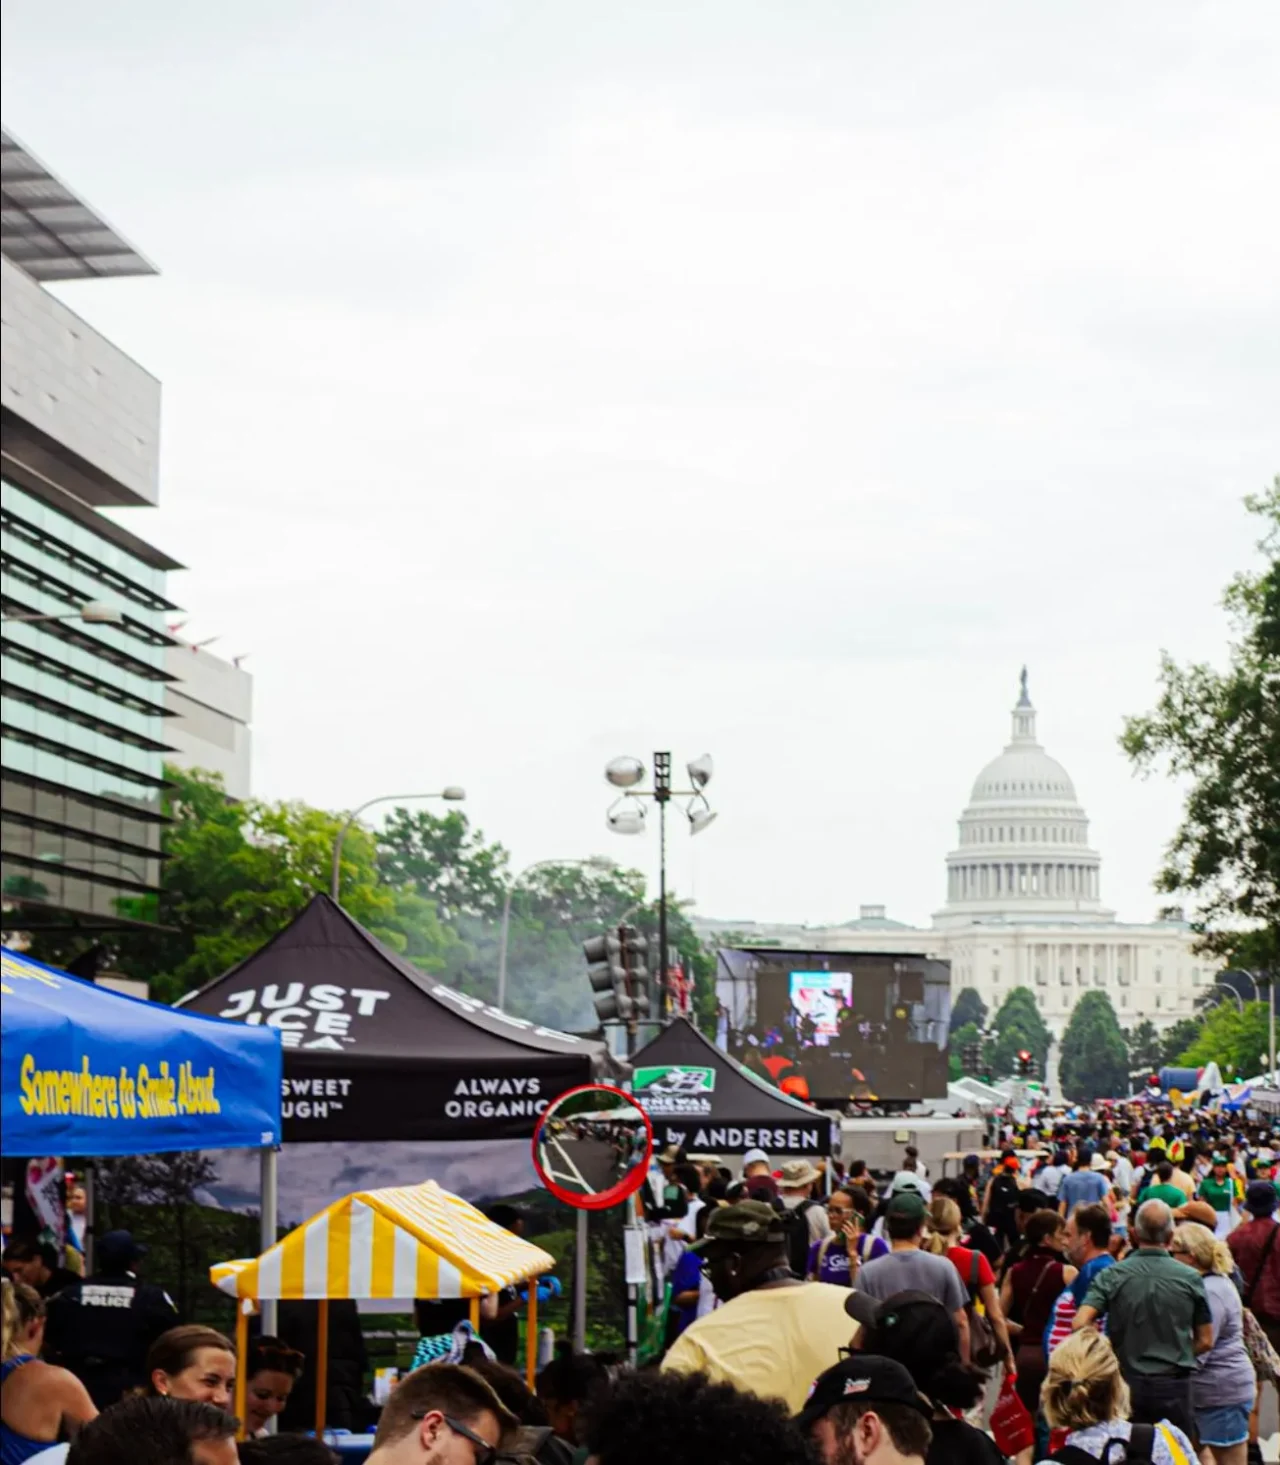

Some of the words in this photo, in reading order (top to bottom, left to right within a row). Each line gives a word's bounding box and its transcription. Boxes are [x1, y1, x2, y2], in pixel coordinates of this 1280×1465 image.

[219, 982, 391, 1018] JUST
[19, 1053, 118, 1119] Somewhere
[119, 1066, 136, 1119] to
[137, 1061, 177, 1118] Smile
[178, 1060, 221, 1115] About.
[454, 1078, 541, 1096] ALWAYS
[444, 1099, 550, 1118] ORGANIC
[666, 1128, 686, 1145] by
[693, 1128, 819, 1148] ANDERSEN
[81, 1295, 132, 1309] POLICE
